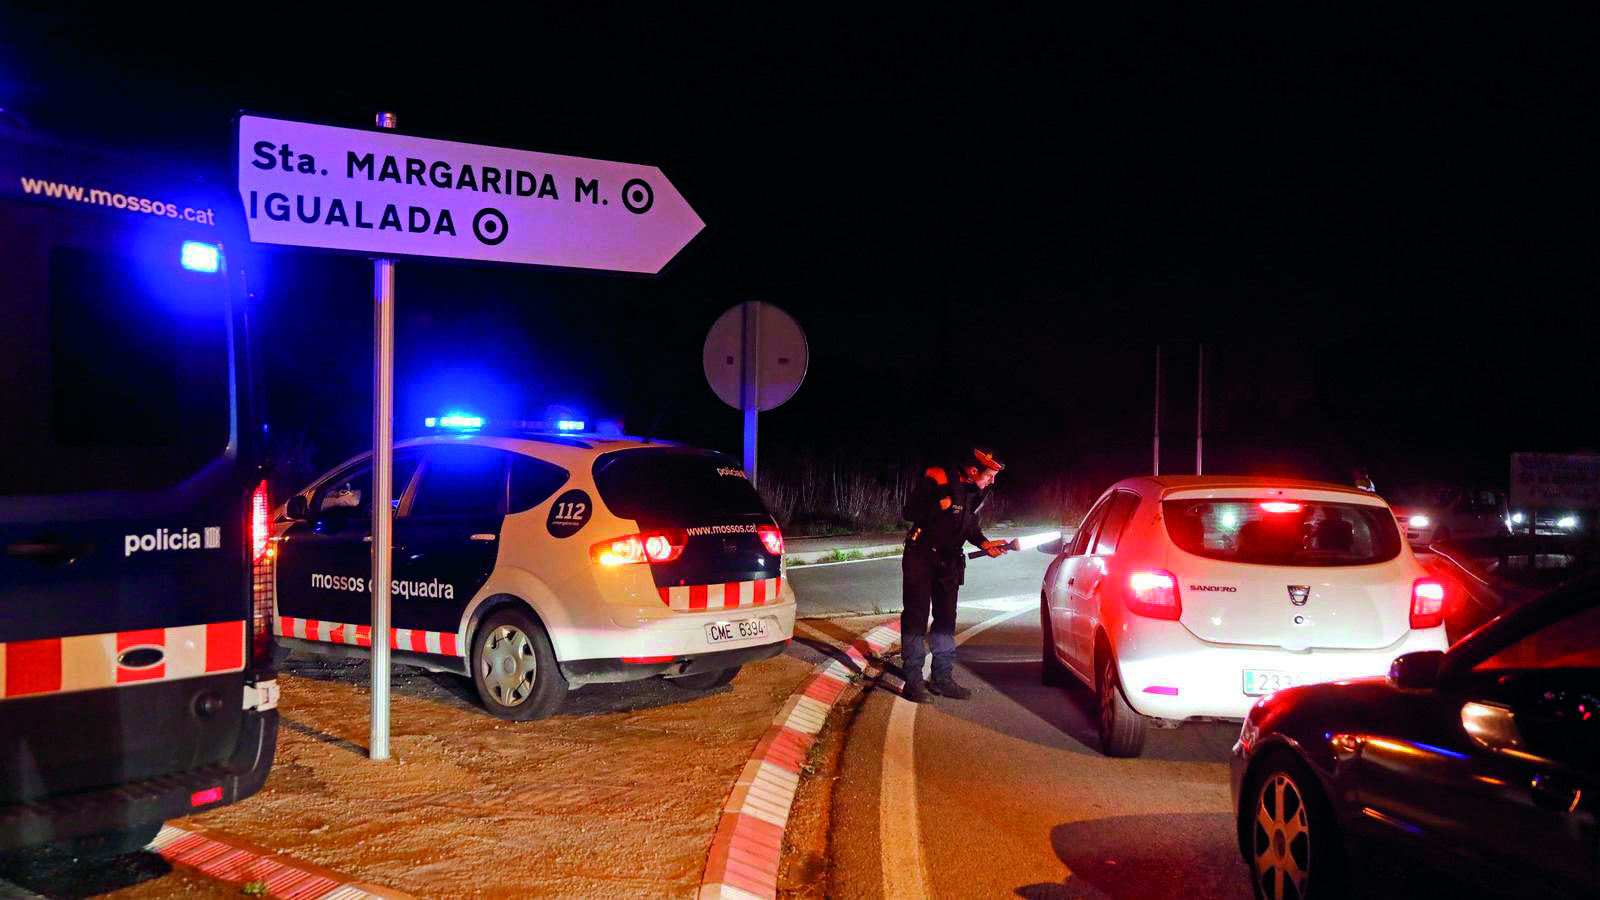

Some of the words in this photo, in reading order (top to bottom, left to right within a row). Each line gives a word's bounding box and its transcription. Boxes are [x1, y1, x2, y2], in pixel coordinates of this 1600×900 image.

[251, 141, 328, 176] Sta.
[347, 151, 559, 200] MARGARIDA
[574, 178, 609, 206] M.
[21, 177, 215, 226] www.mossos.cat
[250, 190, 457, 236] IGUALADA
[555, 502, 585, 520] 112
[125, 528, 200, 557] policia
[687, 523, 758, 536] www.mossos.cat
[311, 573, 364, 592] mossos
[368, 578, 454, 599] squadra
[711, 625, 733, 642] CME
[739, 620, 765, 637] 6394
